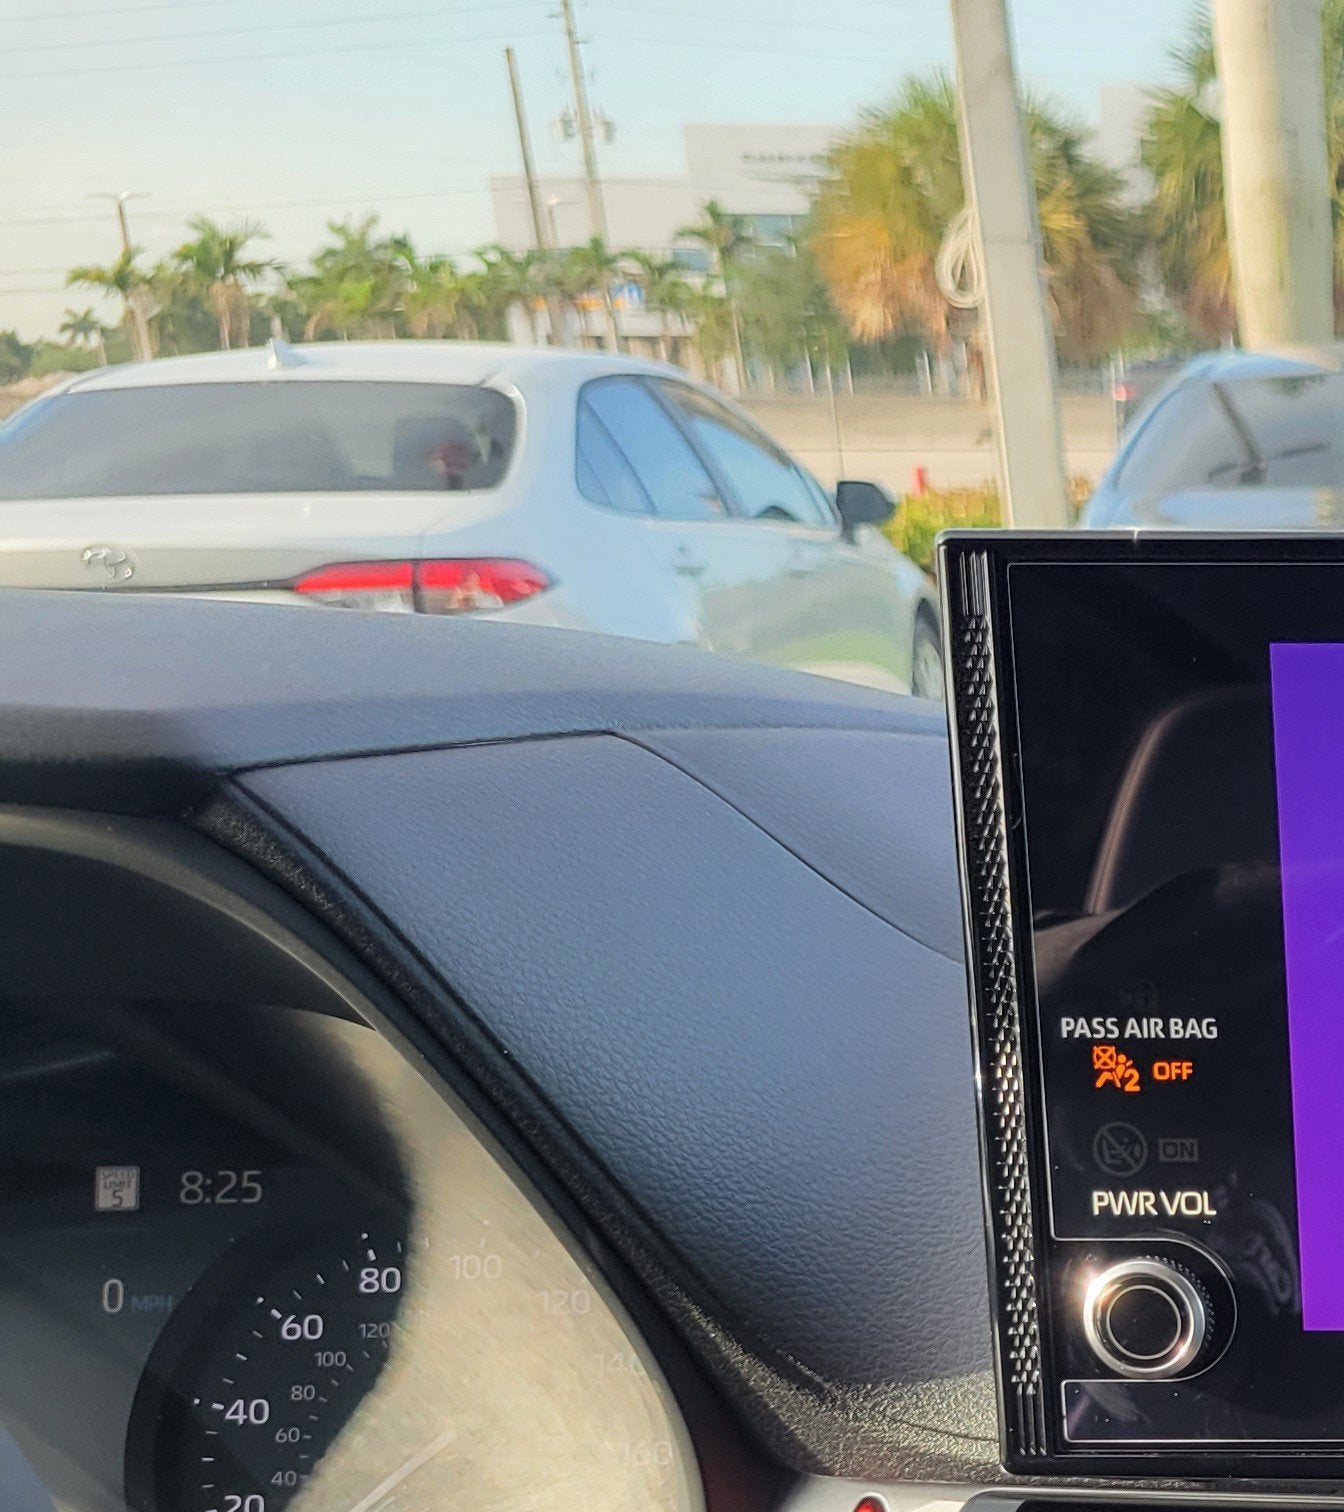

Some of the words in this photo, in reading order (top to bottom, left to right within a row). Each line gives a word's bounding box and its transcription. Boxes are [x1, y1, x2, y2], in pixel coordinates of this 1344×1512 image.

[1061, 1017, 1119, 1039] PASS
[1124, 1017, 1165, 1039] AIR
[1169, 1017, 1217, 1039] BAG
[1153, 1062, 1193, 1081] OFF
[112, 1189, 122, 1207] 5
[180, 1171, 262, 1203] 8:25
[1093, 1191, 1157, 1215] PWR
[1160, 1191, 1217, 1215] VOL
[450, 1255, 501, 1279] 100
[359, 1268, 401, 1293] 80
[103, 1278, 123, 1312] 0
[538, 1290, 590, 1315] 120
[280, 1315, 324, 1340] 60
[359, 1323, 391, 1338] 120
[315, 1351, 347, 1367] 100
[291, 1385, 316, 1401] 80
[225, 1399, 270, 1425] 40
[275, 1427, 300, 1443] 60
[271, 1471, 297, 1487] 40
